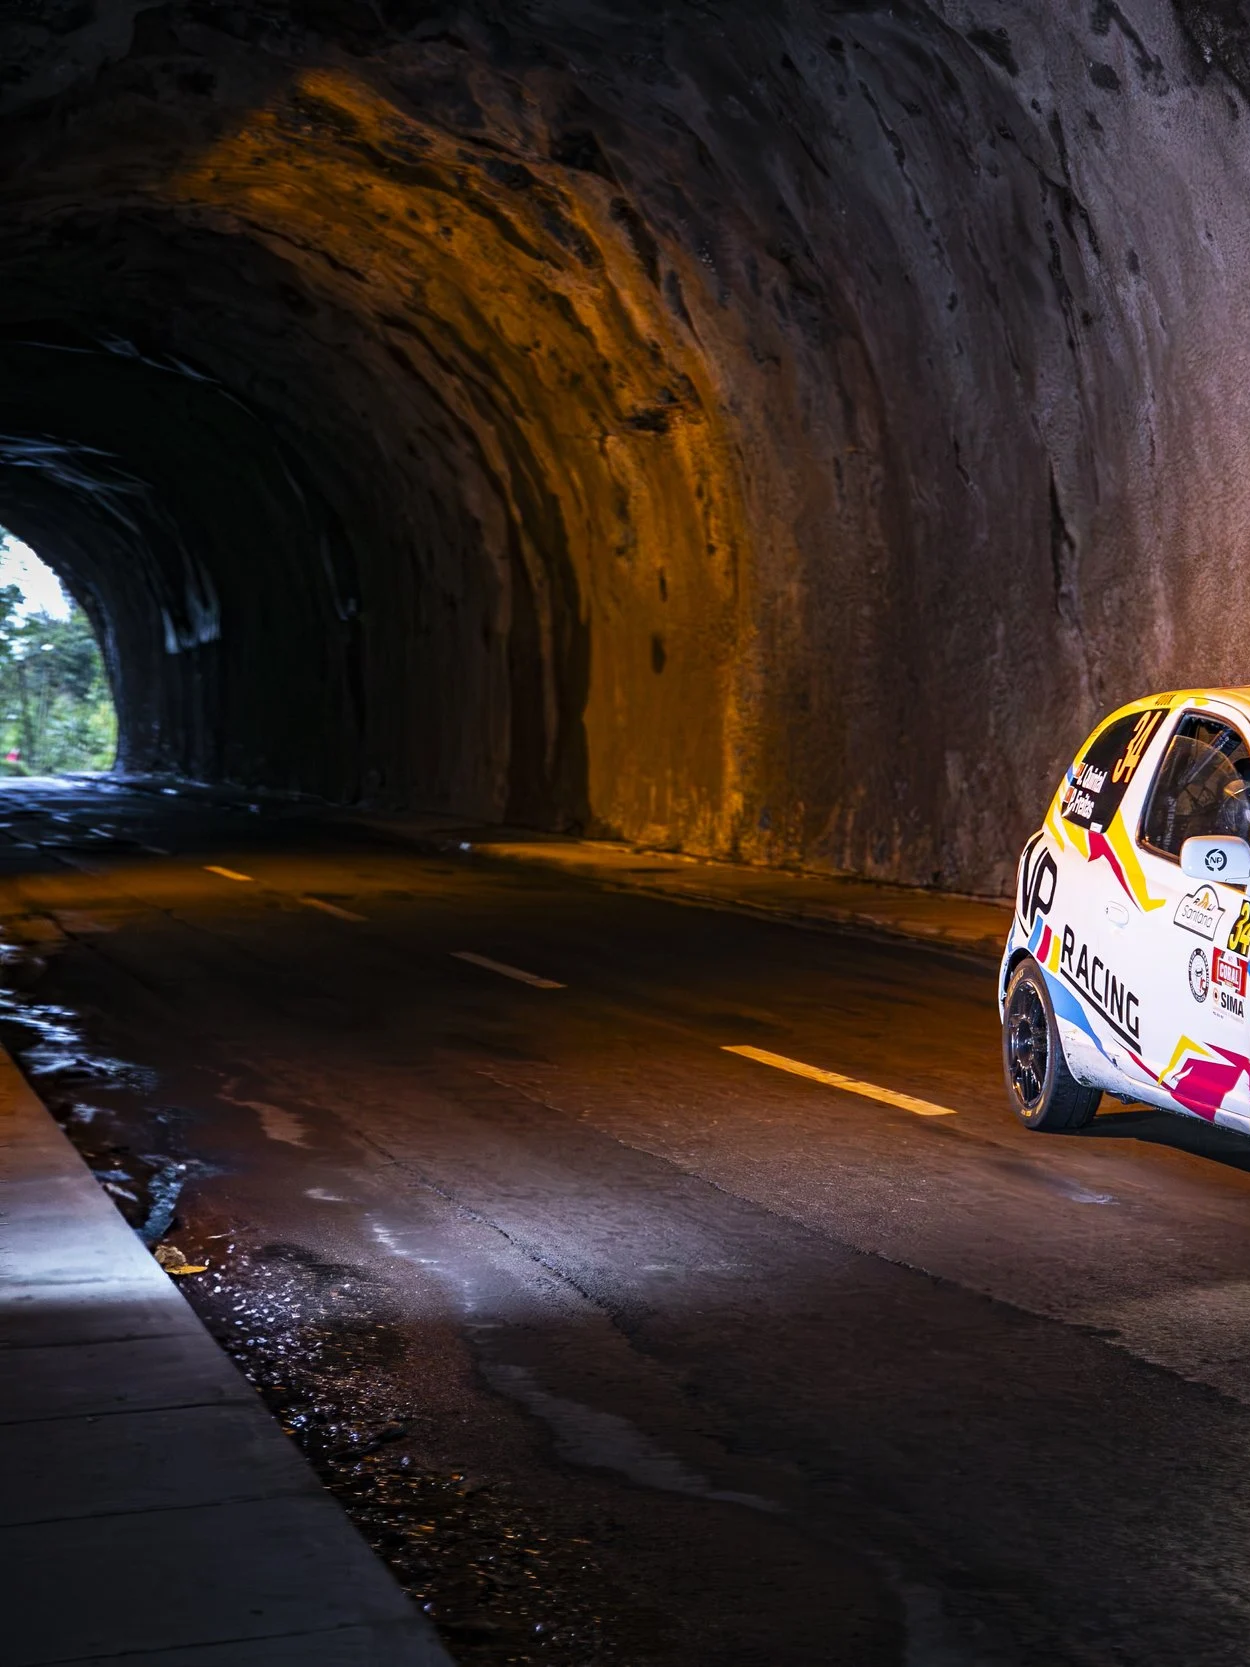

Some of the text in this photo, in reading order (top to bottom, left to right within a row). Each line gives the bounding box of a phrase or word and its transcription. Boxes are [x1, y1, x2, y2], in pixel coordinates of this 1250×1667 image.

[1112, 711, 1162, 783] 34
[1181, 904, 1213, 928] Santana
[1061, 924, 1140, 1039] RACING
[1220, 992, 1245, 1018] SIMA
